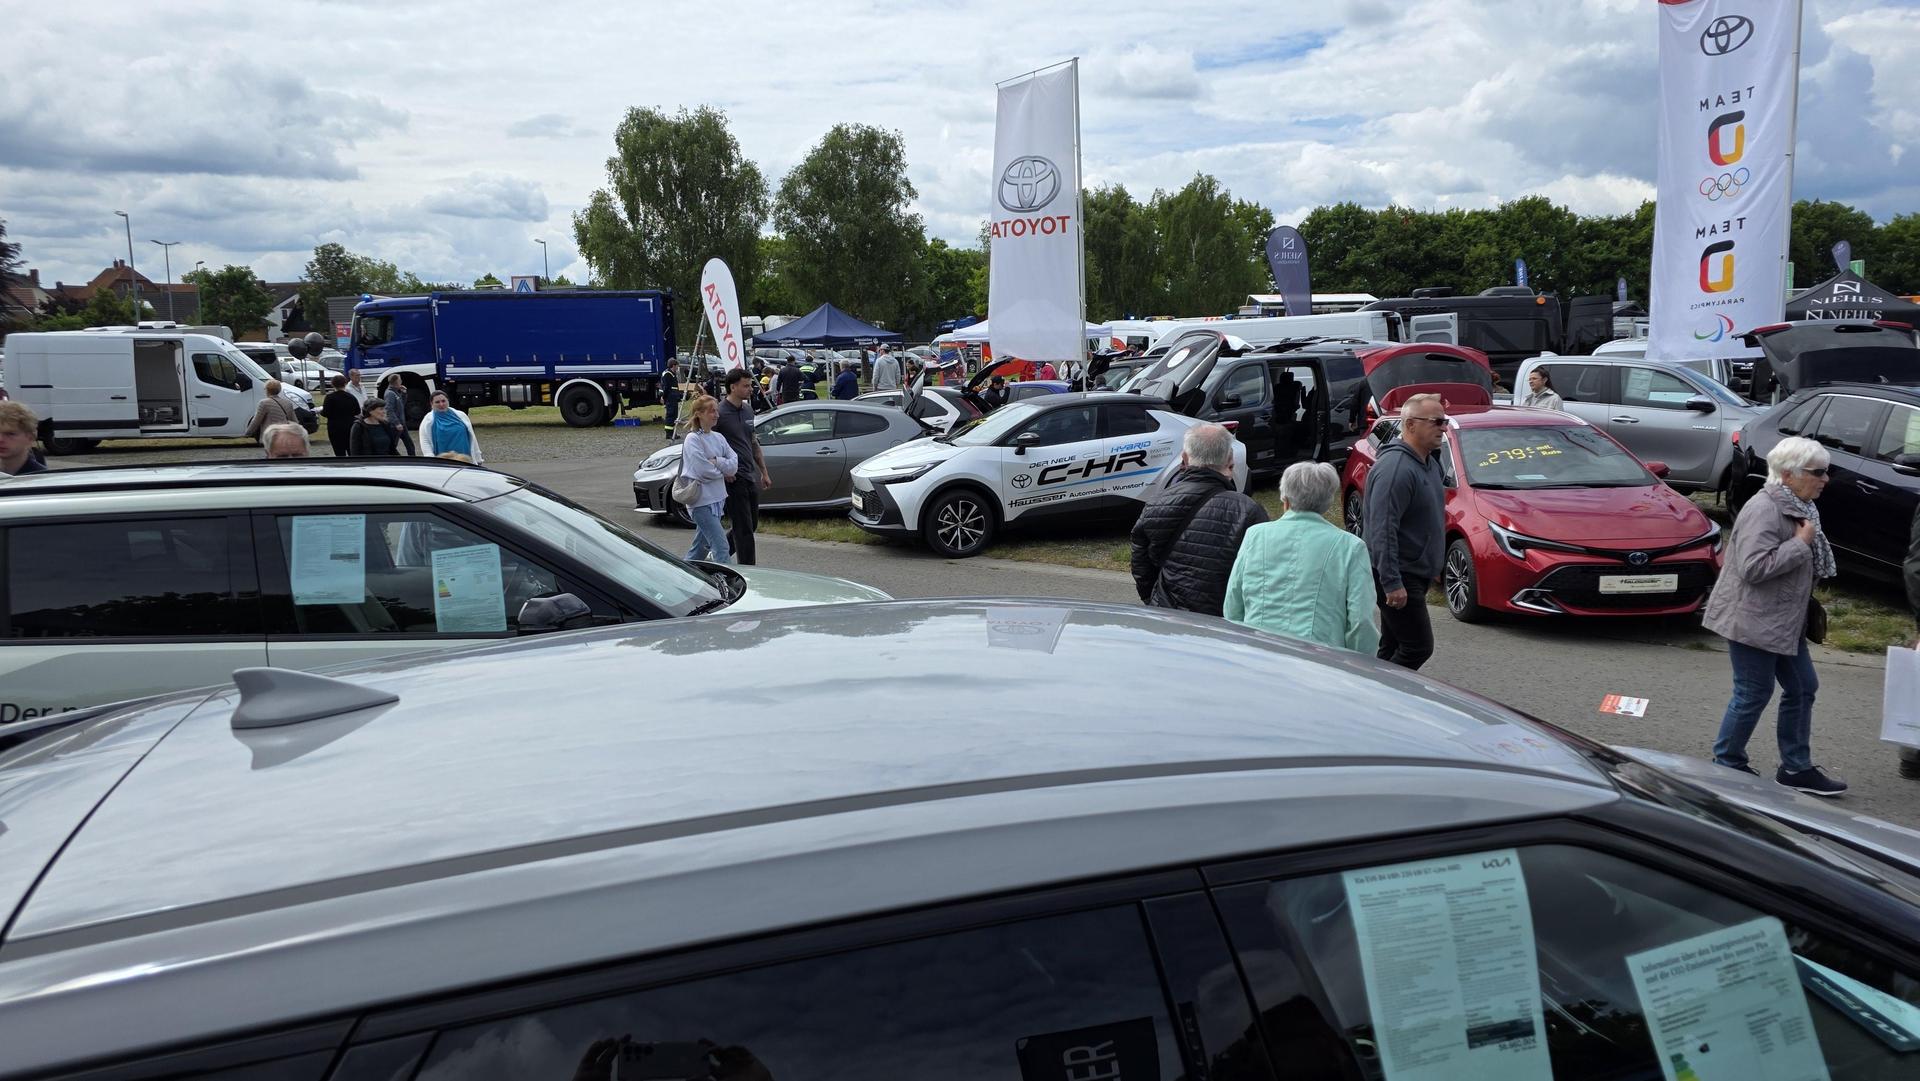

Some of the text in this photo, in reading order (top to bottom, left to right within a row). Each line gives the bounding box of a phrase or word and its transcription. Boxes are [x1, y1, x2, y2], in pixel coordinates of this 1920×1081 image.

[1810, 294, 1884, 305] NIEHUS
[1828, 309, 1883, 320] NIEHUS
[1110, 440, 1151, 453] HYBRID
[1028, 454, 1077, 469] DER NEUE
[1037, 450, 1149, 486] C-HR
[1068, 487, 1107, 498] Automobile
[1112, 481, 1145, 492] Wunstorf
